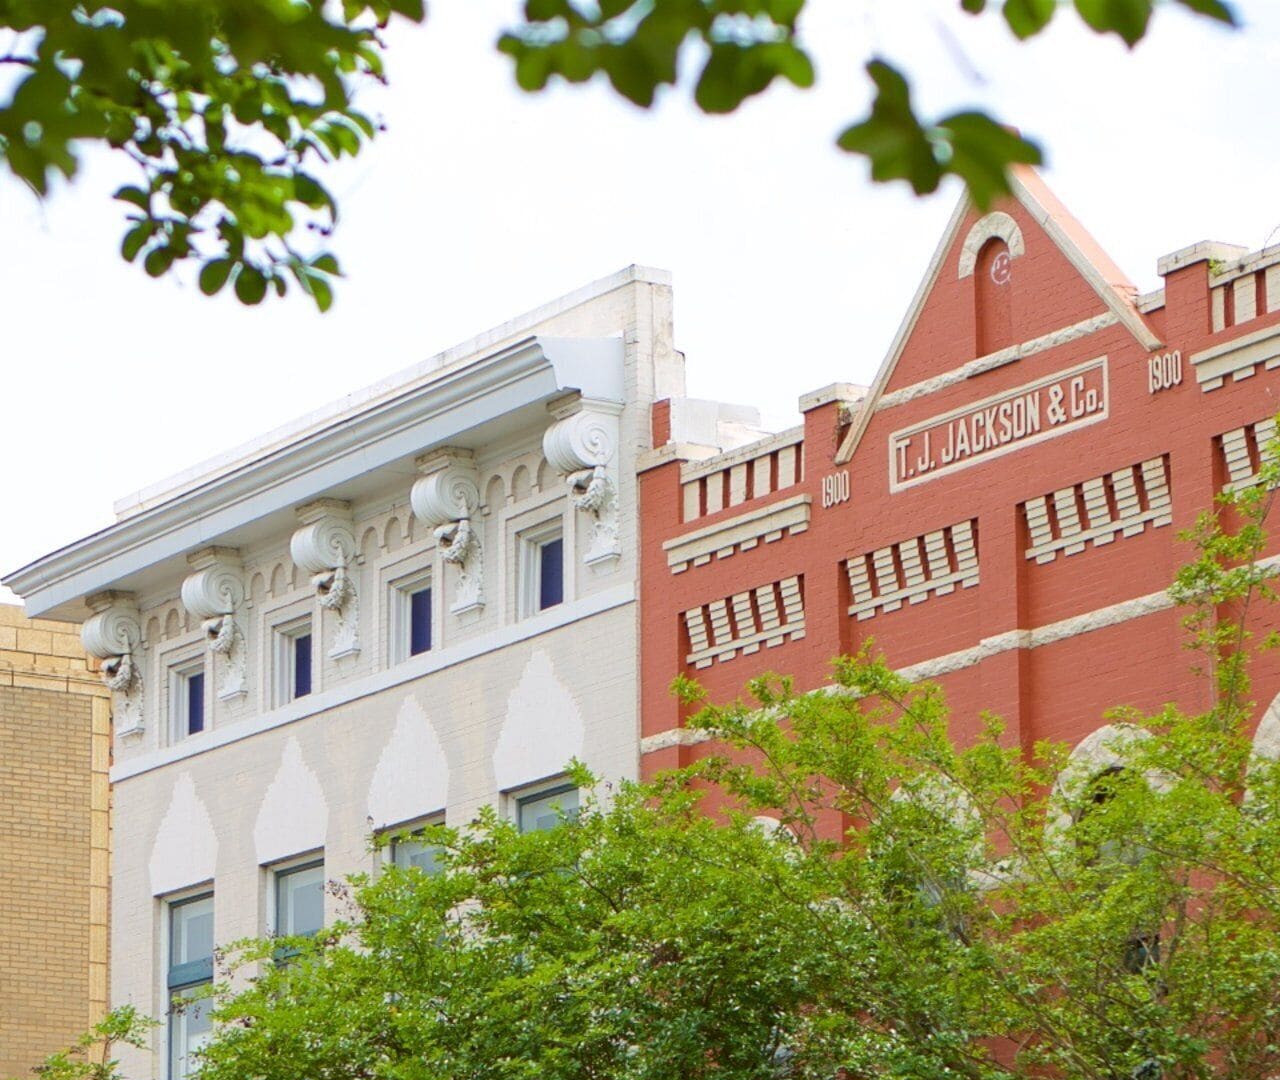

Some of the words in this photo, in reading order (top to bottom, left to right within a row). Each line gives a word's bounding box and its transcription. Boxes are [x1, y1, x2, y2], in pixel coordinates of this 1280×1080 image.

[1147, 349, 1183, 395] 1900
[941, 391, 1041, 464] JACKSON
[1046, 383, 1068, 426] &
[1070, 375, 1105, 419] Co.
[821, 469, 851, 509] 1900
